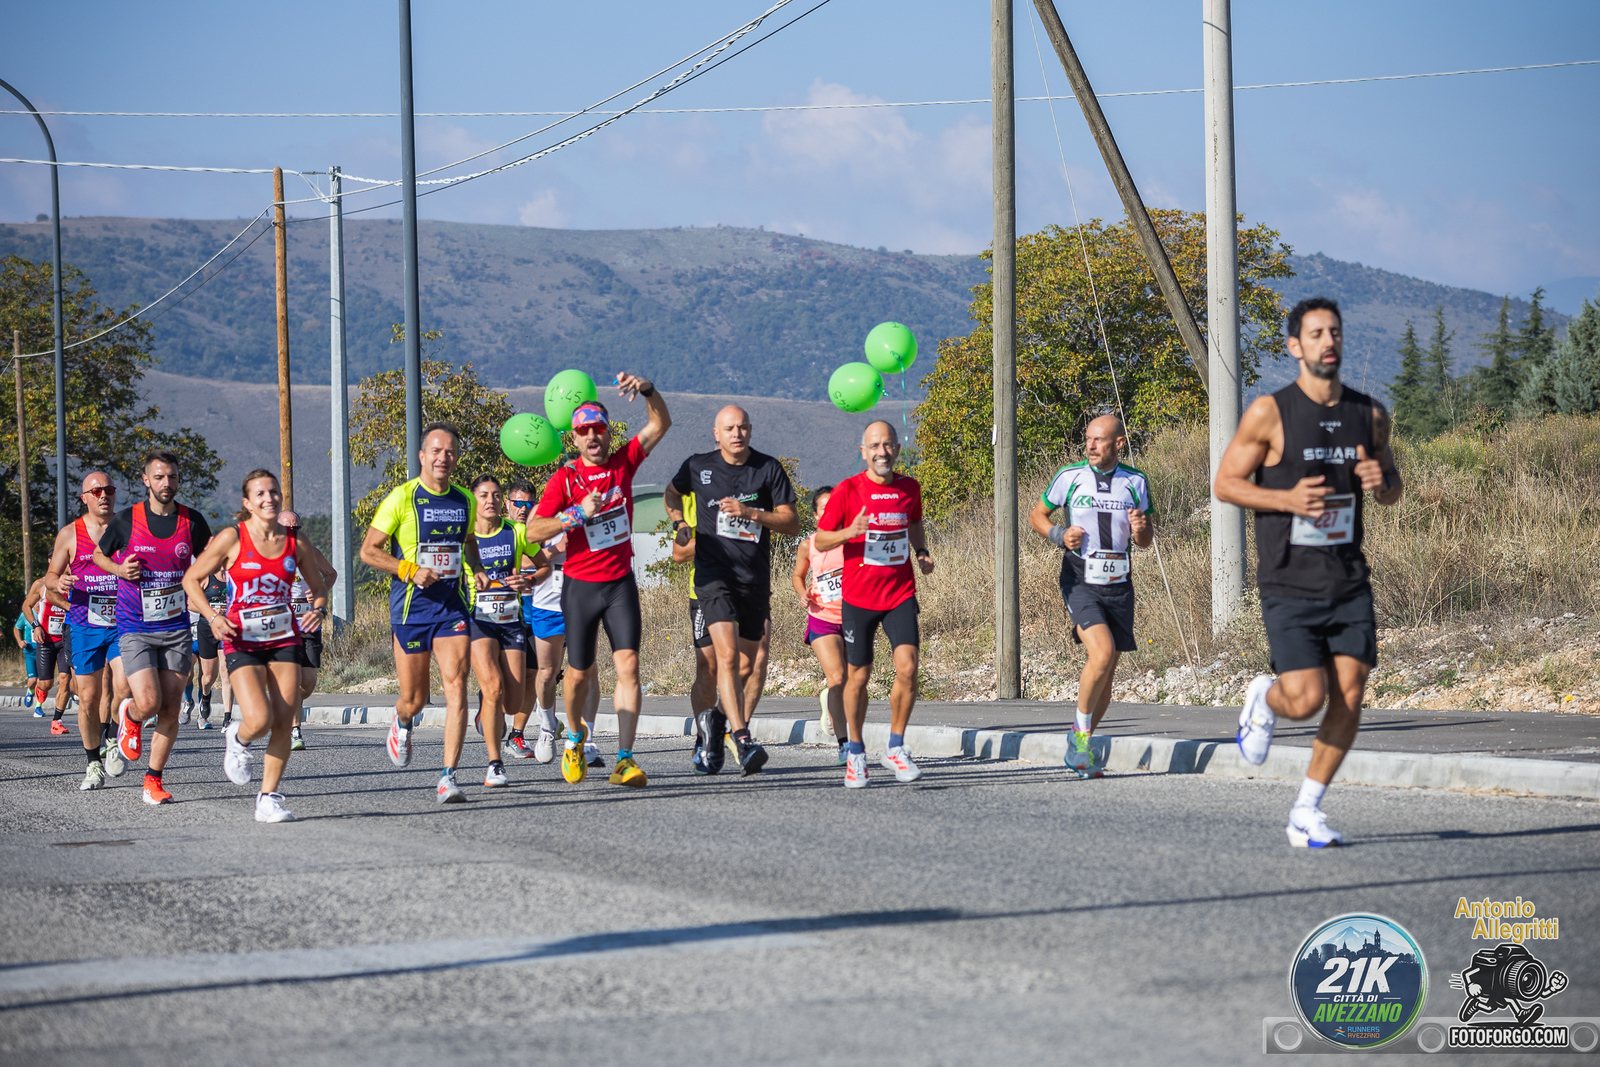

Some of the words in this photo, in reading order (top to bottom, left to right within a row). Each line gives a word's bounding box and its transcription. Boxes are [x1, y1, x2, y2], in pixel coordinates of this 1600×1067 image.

[1303, 446, 1361, 461] SQUAR
[602, 520, 616, 535] 39
[882, 541, 896, 553] 46
[432, 553, 450, 567] 193
[1102, 560, 1116, 573] 66
[154, 595, 176, 611] 274
[492, 602, 505, 614] 98
[261, 617, 276, 631] 56
